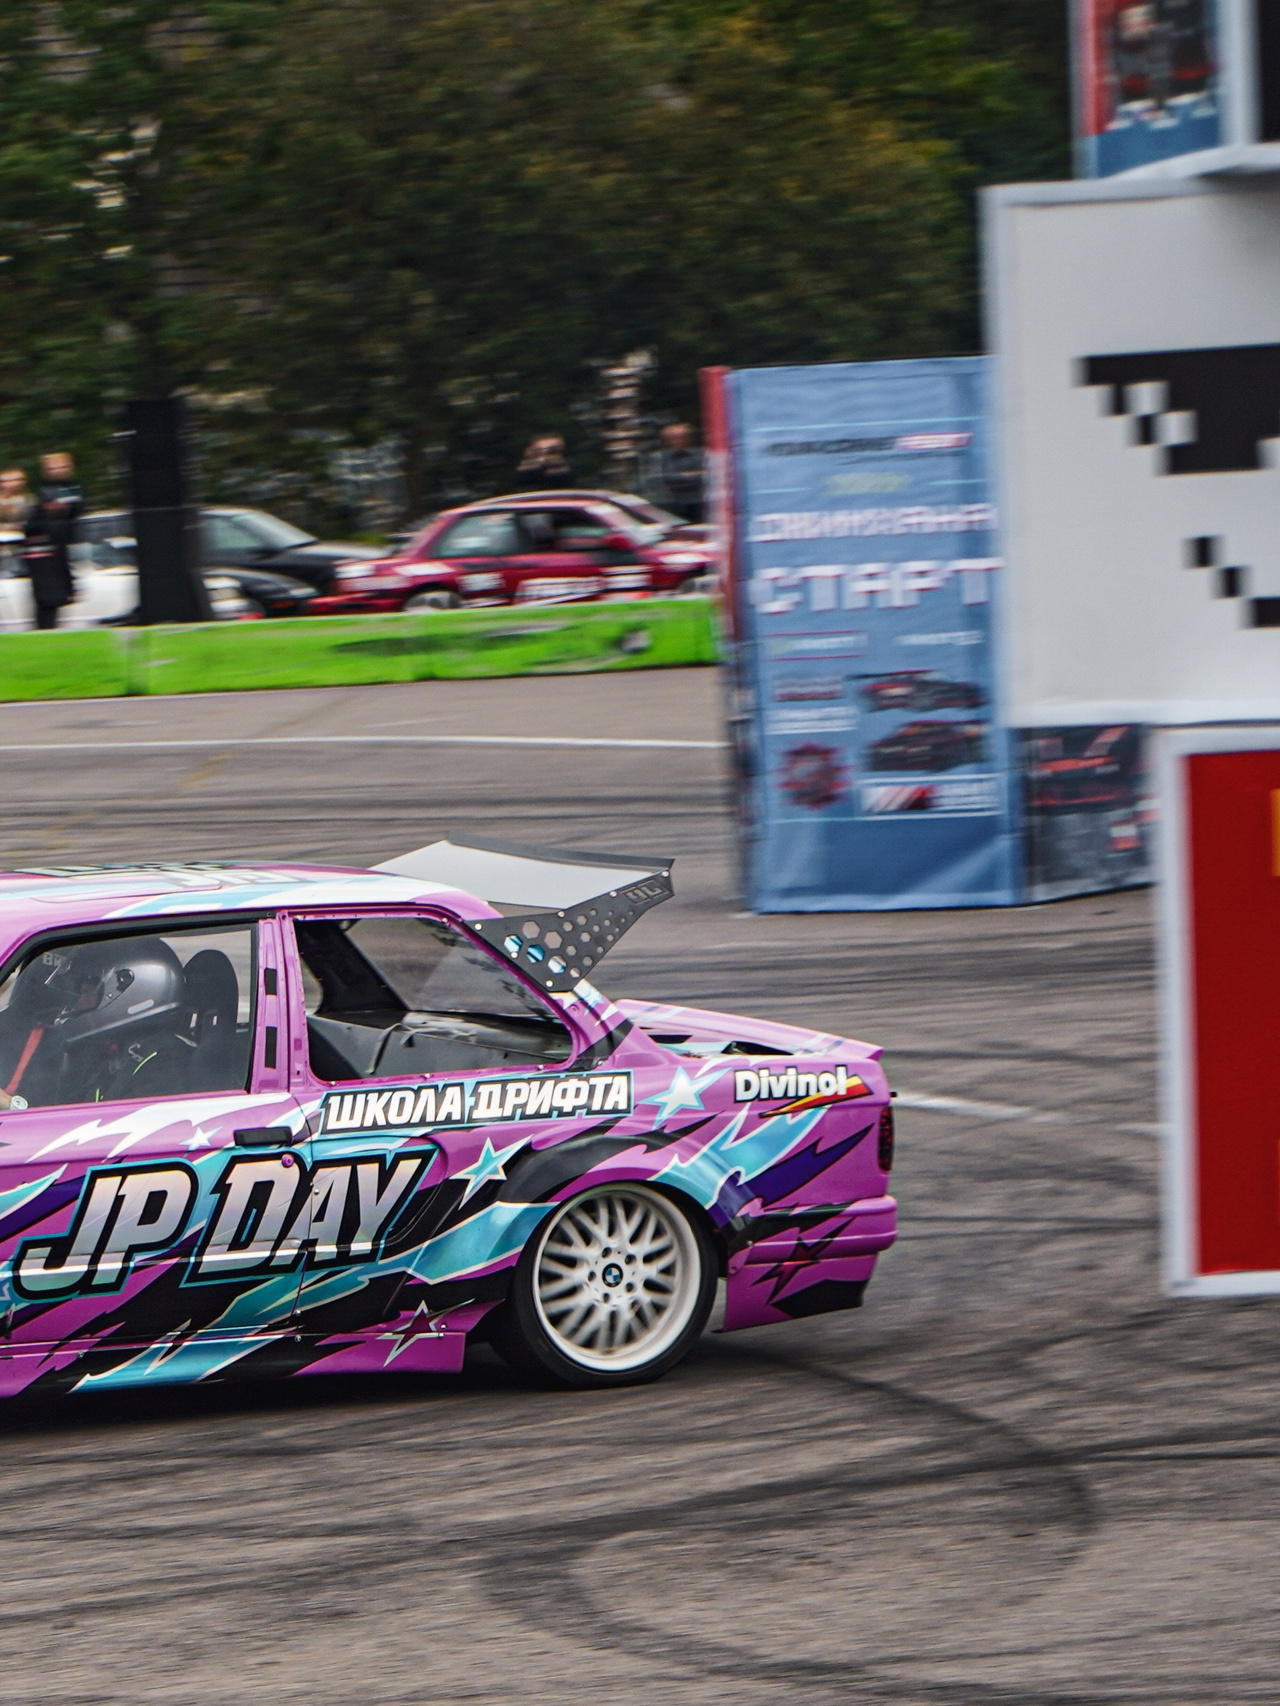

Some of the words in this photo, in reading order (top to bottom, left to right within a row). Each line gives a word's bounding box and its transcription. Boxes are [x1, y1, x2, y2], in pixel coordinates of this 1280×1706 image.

[752, 557, 1006, 616] СТАРТ
[323, 1084, 463, 1132] ШКОЛА
[470, 1073, 630, 1121] ДРИФТА
[734, 1064, 848, 1102] Divinol
[17, 1167, 195, 1293] JP
[195, 1156, 423, 1276] DAY
